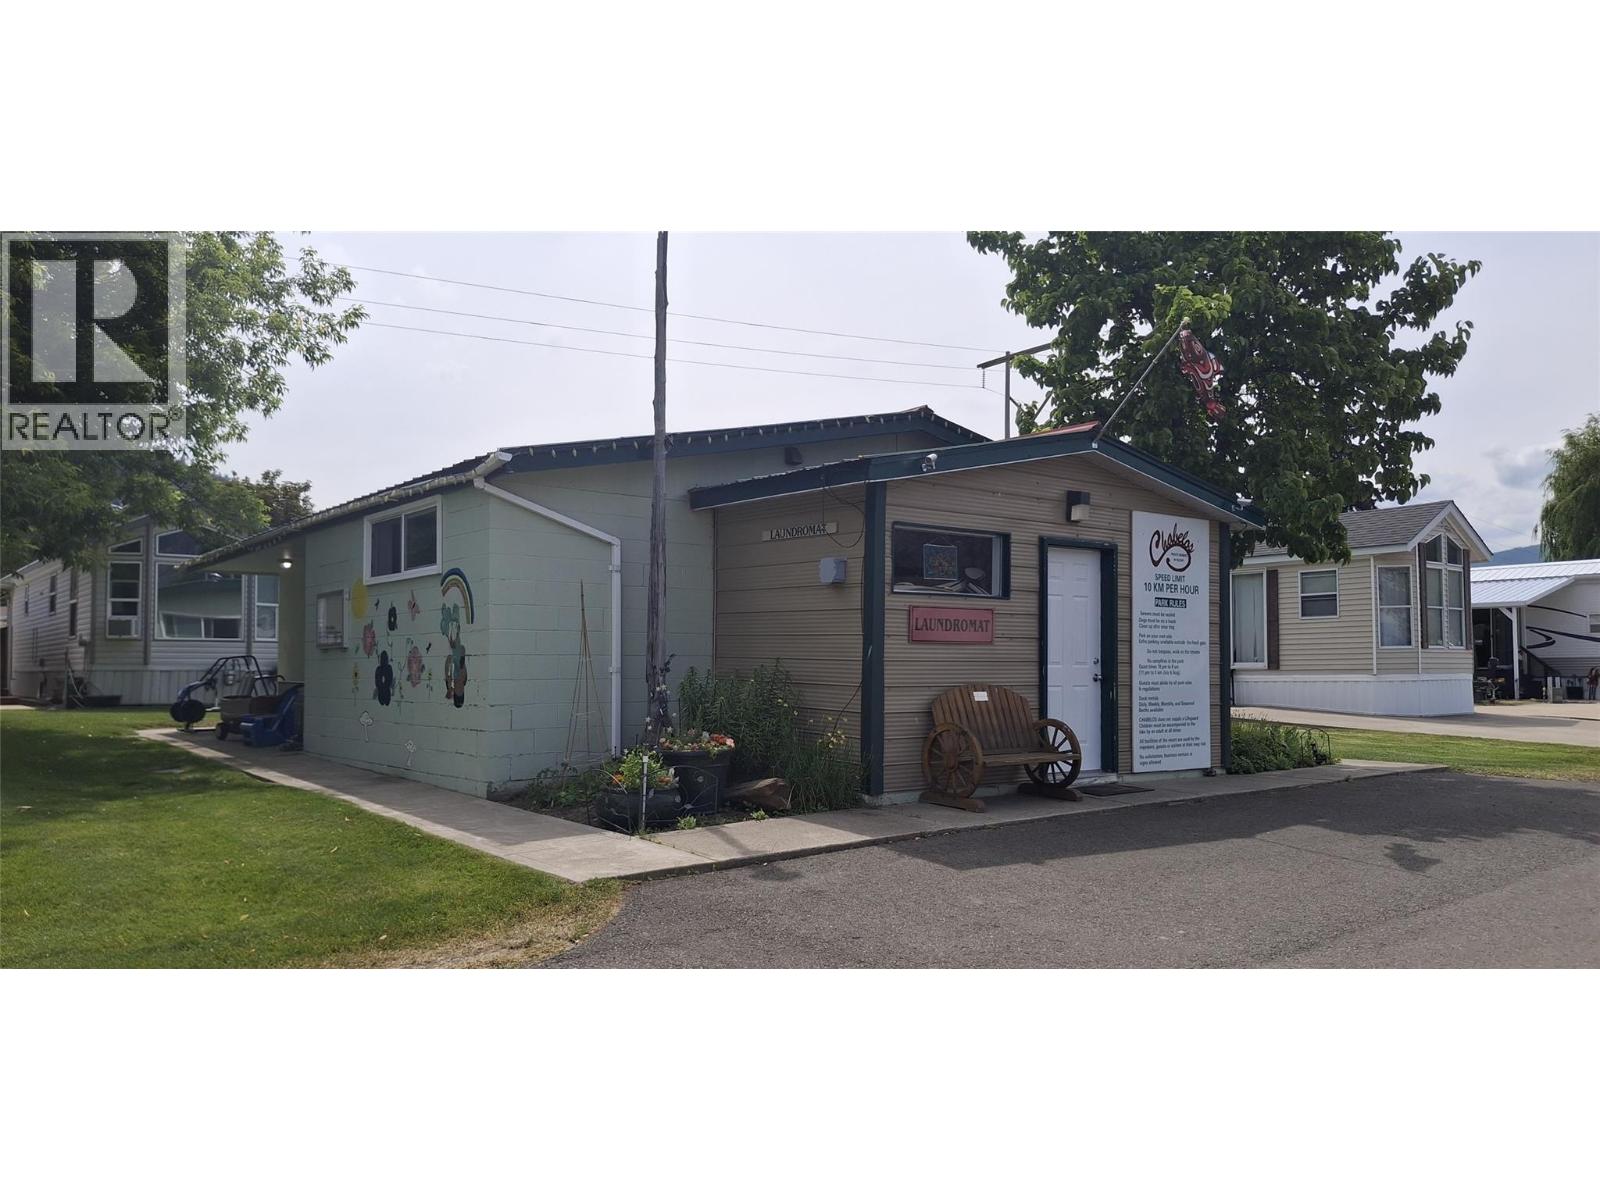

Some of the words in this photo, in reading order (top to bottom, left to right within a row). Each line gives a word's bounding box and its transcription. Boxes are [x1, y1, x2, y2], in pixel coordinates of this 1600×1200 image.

[770, 523, 827, 540] LAUNDROMAT
[1155, 573, 1171, 582] SPEED
[1172, 575, 1185, 583] LIMIT
[1144, 582, 1152, 592] 10
[1153, 583, 1164, 593] KM
[1166, 583, 1178, 593] PER
[1180, 585, 1199, 595] HOUR
[1155, 599, 1168, 607] PARK
[1169, 600, 1185, 608] RULES
[914, 617, 991, 633] LAUNDROMAT
